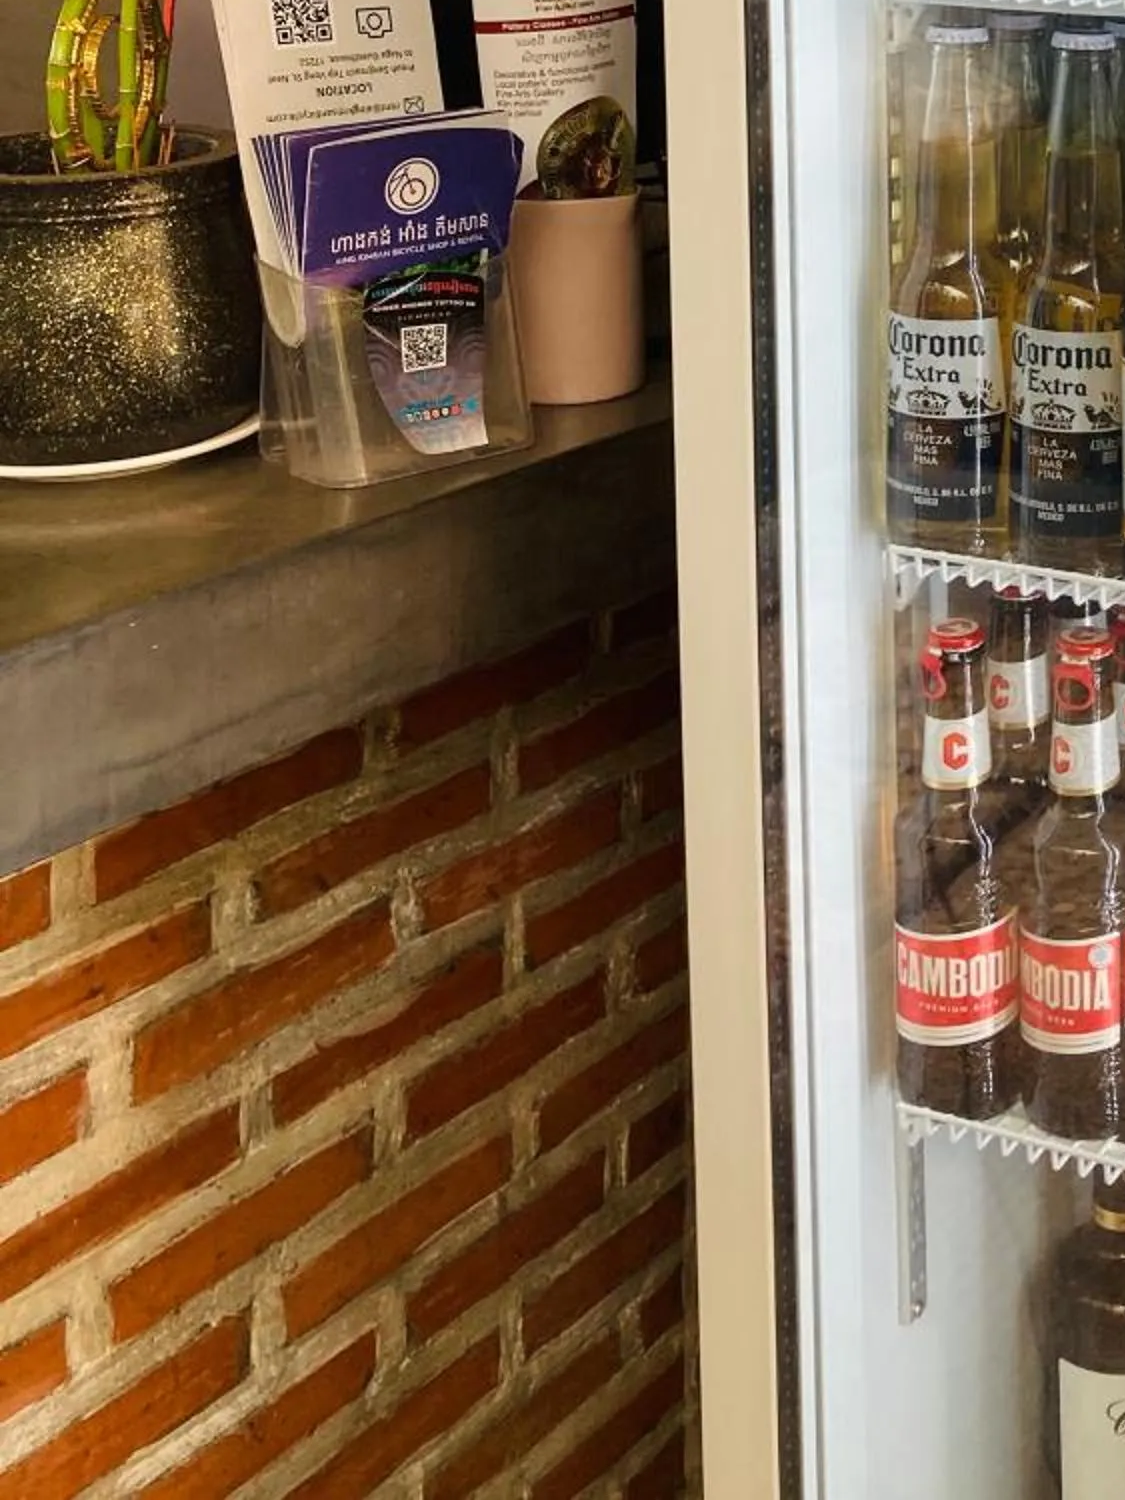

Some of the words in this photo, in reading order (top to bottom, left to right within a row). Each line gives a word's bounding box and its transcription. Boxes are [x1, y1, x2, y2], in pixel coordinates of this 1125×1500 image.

[315, 82, 374, 97] LOCATION
[391, 245, 425, 258] BICYCLE
[427, 240, 449, 251] SHOP
[889, 315, 987, 357] Corona
[1012, 328, 1113, 369] Corona
[898, 356, 961, 384] Extra
[1022, 369, 1088, 397] Extra
[990, 675, 1010, 710] C
[942, 731, 969, 772] C
[1051, 735, 1072, 775] C
